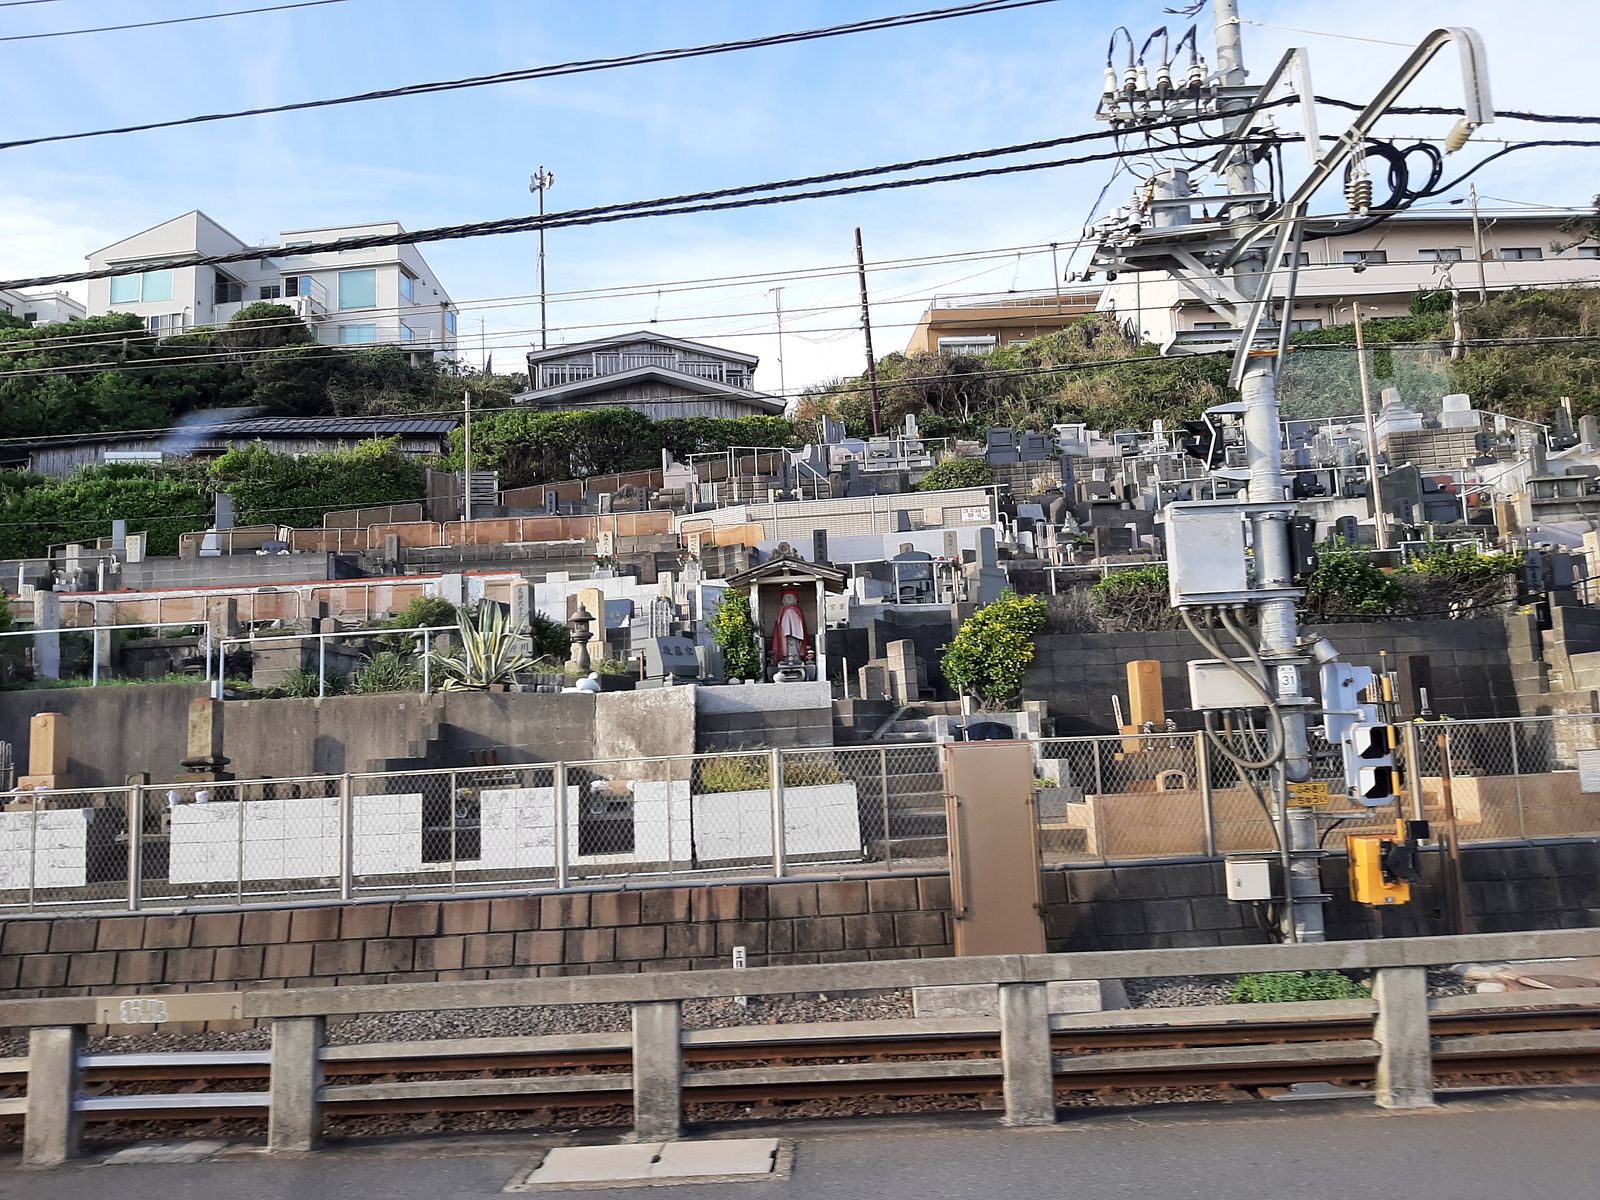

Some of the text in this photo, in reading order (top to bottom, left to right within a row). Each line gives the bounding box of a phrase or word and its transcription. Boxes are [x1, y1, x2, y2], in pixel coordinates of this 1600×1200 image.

[1281, 675, 1294, 686] 31
[1296, 784, 1325, 794] ふみきり
[1297, 795, 1327, 805] ちゅうい
